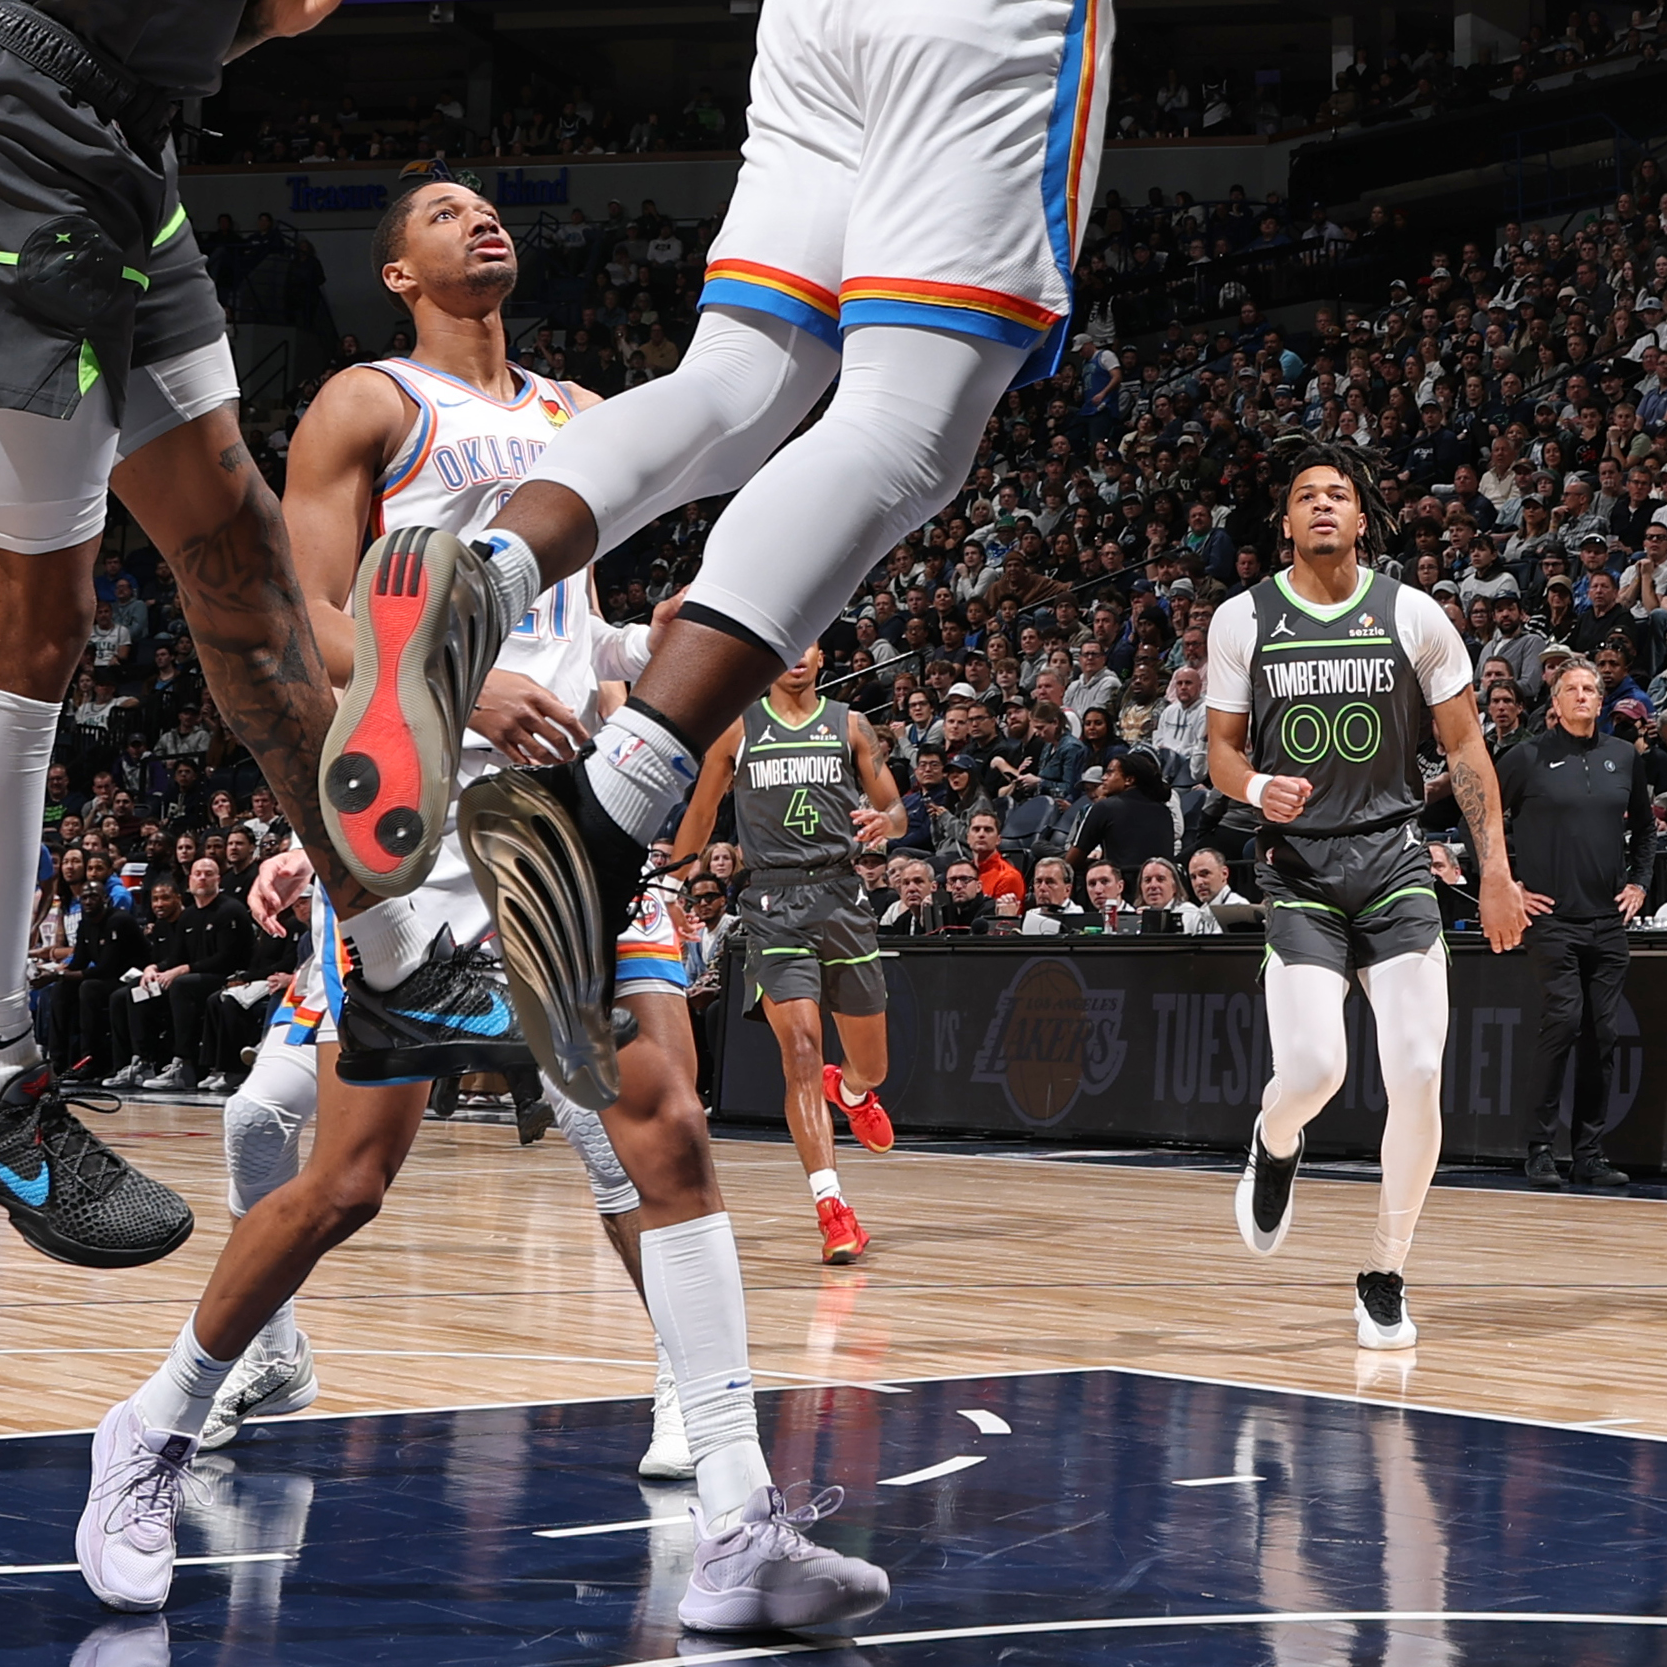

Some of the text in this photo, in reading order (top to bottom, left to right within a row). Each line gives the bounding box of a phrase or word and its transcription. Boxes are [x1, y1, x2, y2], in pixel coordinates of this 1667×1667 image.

[287, 166, 570, 212] Treasure Island
[432, 435, 547, 492] OKLA
[1261, 657, 1396, 702] TIMBERWOLVES
[1280, 701, 1382, 764] 00
[747, 755, 843, 791] TIMBERWOLVES
[783, 788, 819, 836] 4
[1027, 995, 1119, 1013] LOS ANGELES
[1152, 991, 1267, 1106] TUES
[1469, 1006, 1521, 1116] ET
